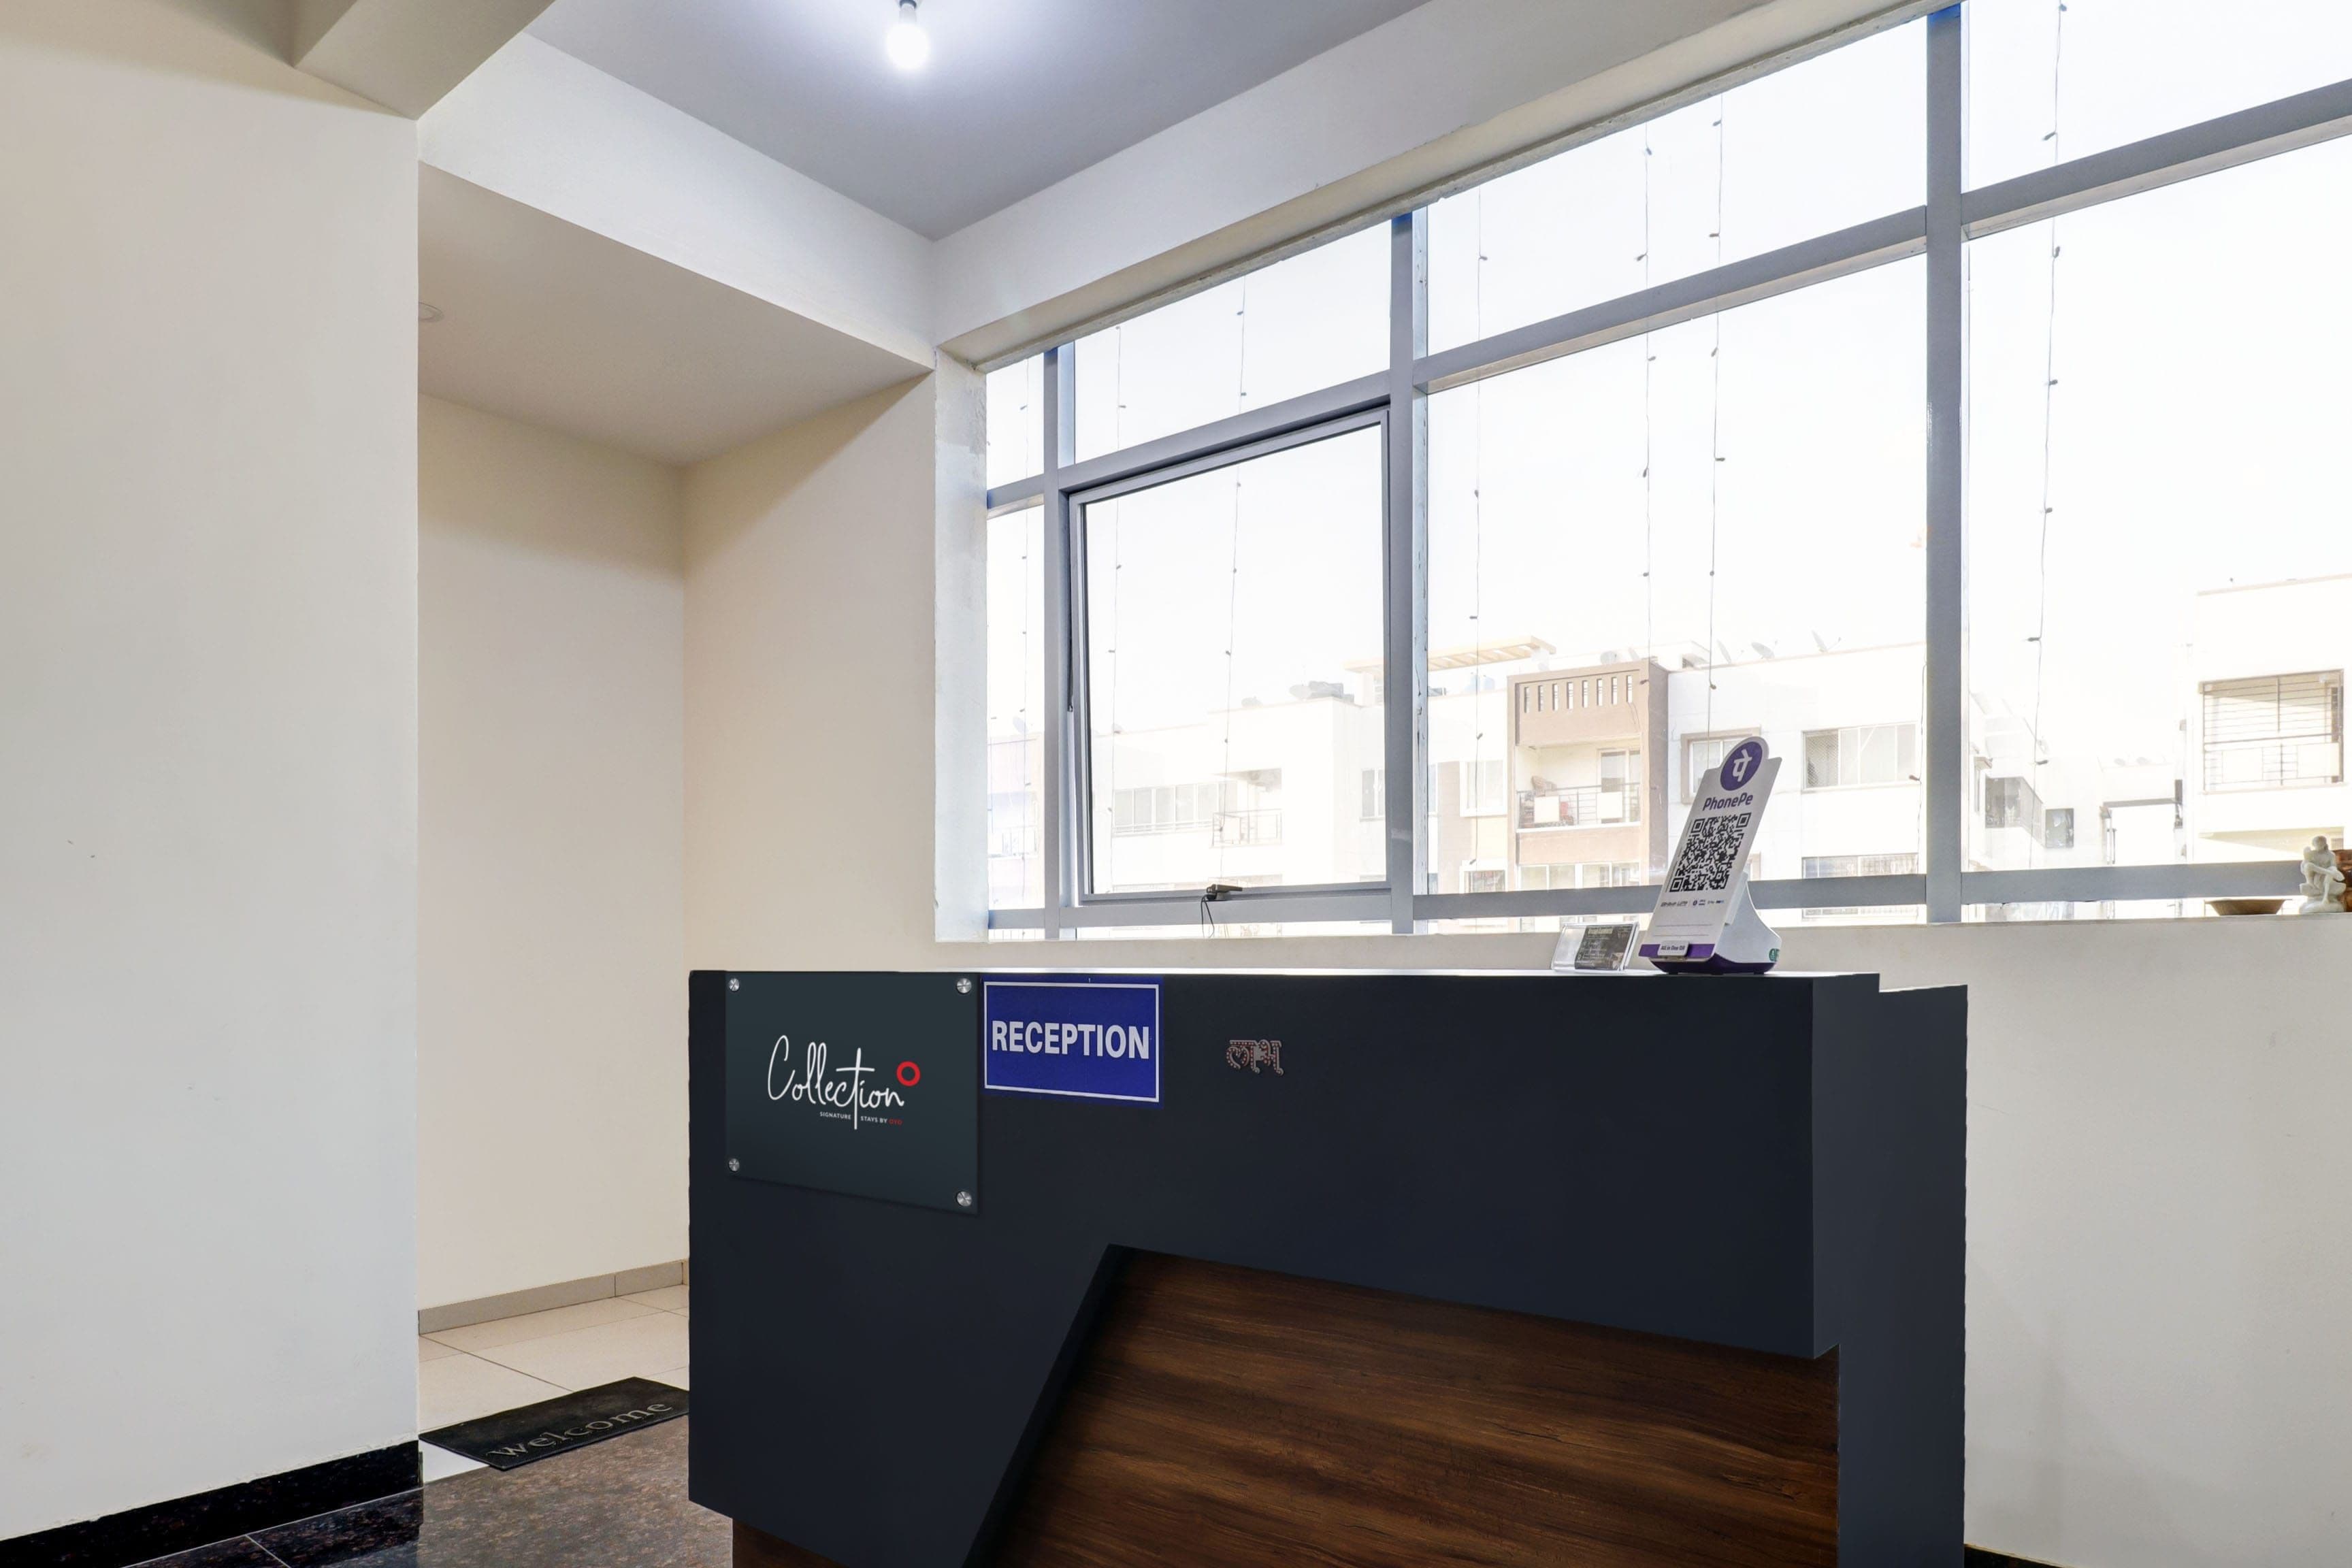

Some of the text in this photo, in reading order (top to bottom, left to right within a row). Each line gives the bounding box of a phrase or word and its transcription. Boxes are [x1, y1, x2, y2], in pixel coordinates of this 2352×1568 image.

[1703, 792, 1753, 811] PhonePe
[992, 1021, 1149, 1059] RECEPTION
[768, 1035, 904, 1130] Collection
[819, 1111, 851, 1120] SIGNATURE
[485, 1403, 672, 1458] welcome
